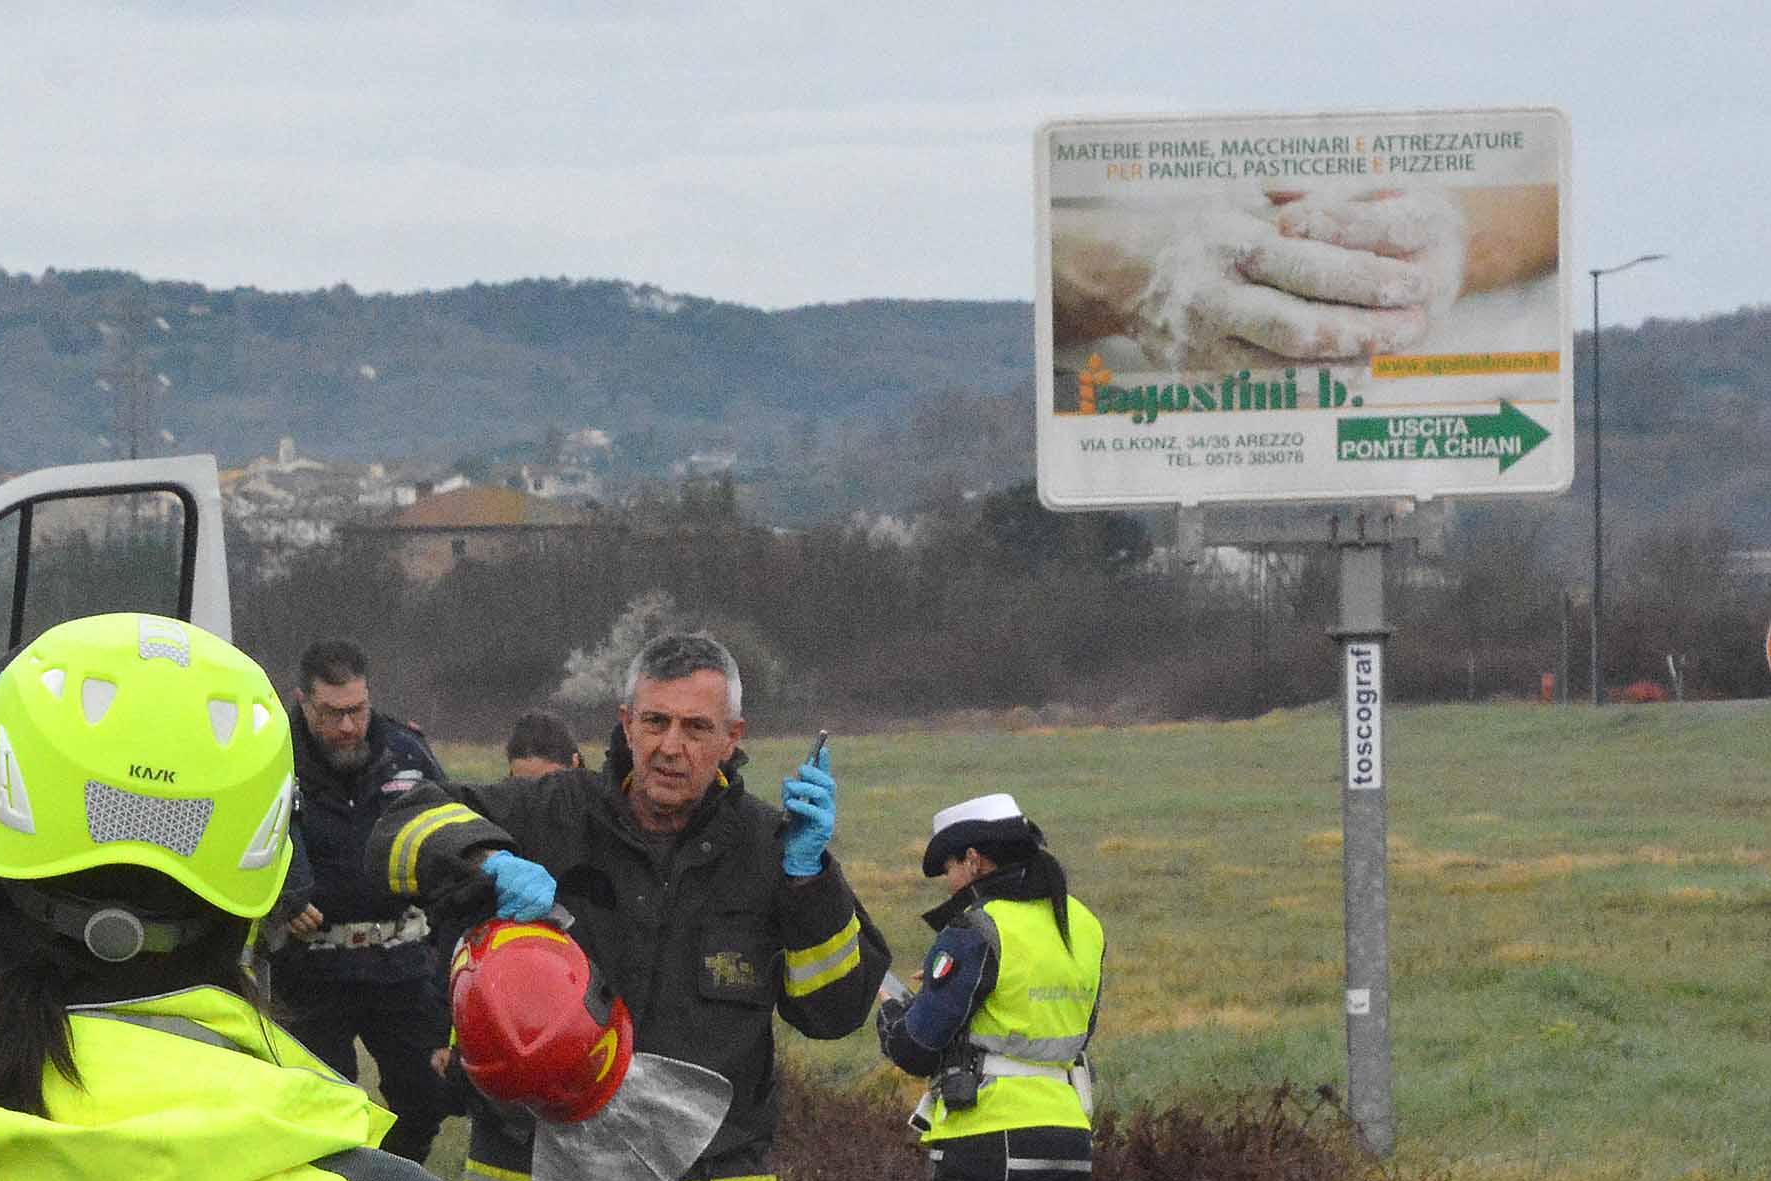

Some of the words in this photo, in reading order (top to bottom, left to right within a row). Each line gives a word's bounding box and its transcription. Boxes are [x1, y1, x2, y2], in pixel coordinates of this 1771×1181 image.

[1057, 142, 1142, 161] MATERIE
[1148, 139, 1215, 160] PRIME,
[1221, 135, 1350, 158] MACCHINARI
[1372, 131, 1525, 152] ATTREZZATURE
[1107, 163, 1143, 180] PER
[1148, 160, 1237, 180] PANIFICI,
[1244, 157, 1367, 177] PASTICCERIE
[1389, 153, 1476, 173] PIZZERIE
[1318, 368, 1365, 409] b.
[1387, 416, 1469, 437] USCITA
[1080, 438, 1102, 452] VIA
[1235, 431, 1305, 448] AREZZO
[1340, 437, 1417, 460] PONTE
[1422, 438, 1439, 457] A
[1444, 435, 1522, 457] CHIANI
[1205, 451, 1244, 467] 0575
[1350, 647, 1378, 785] toscograf
